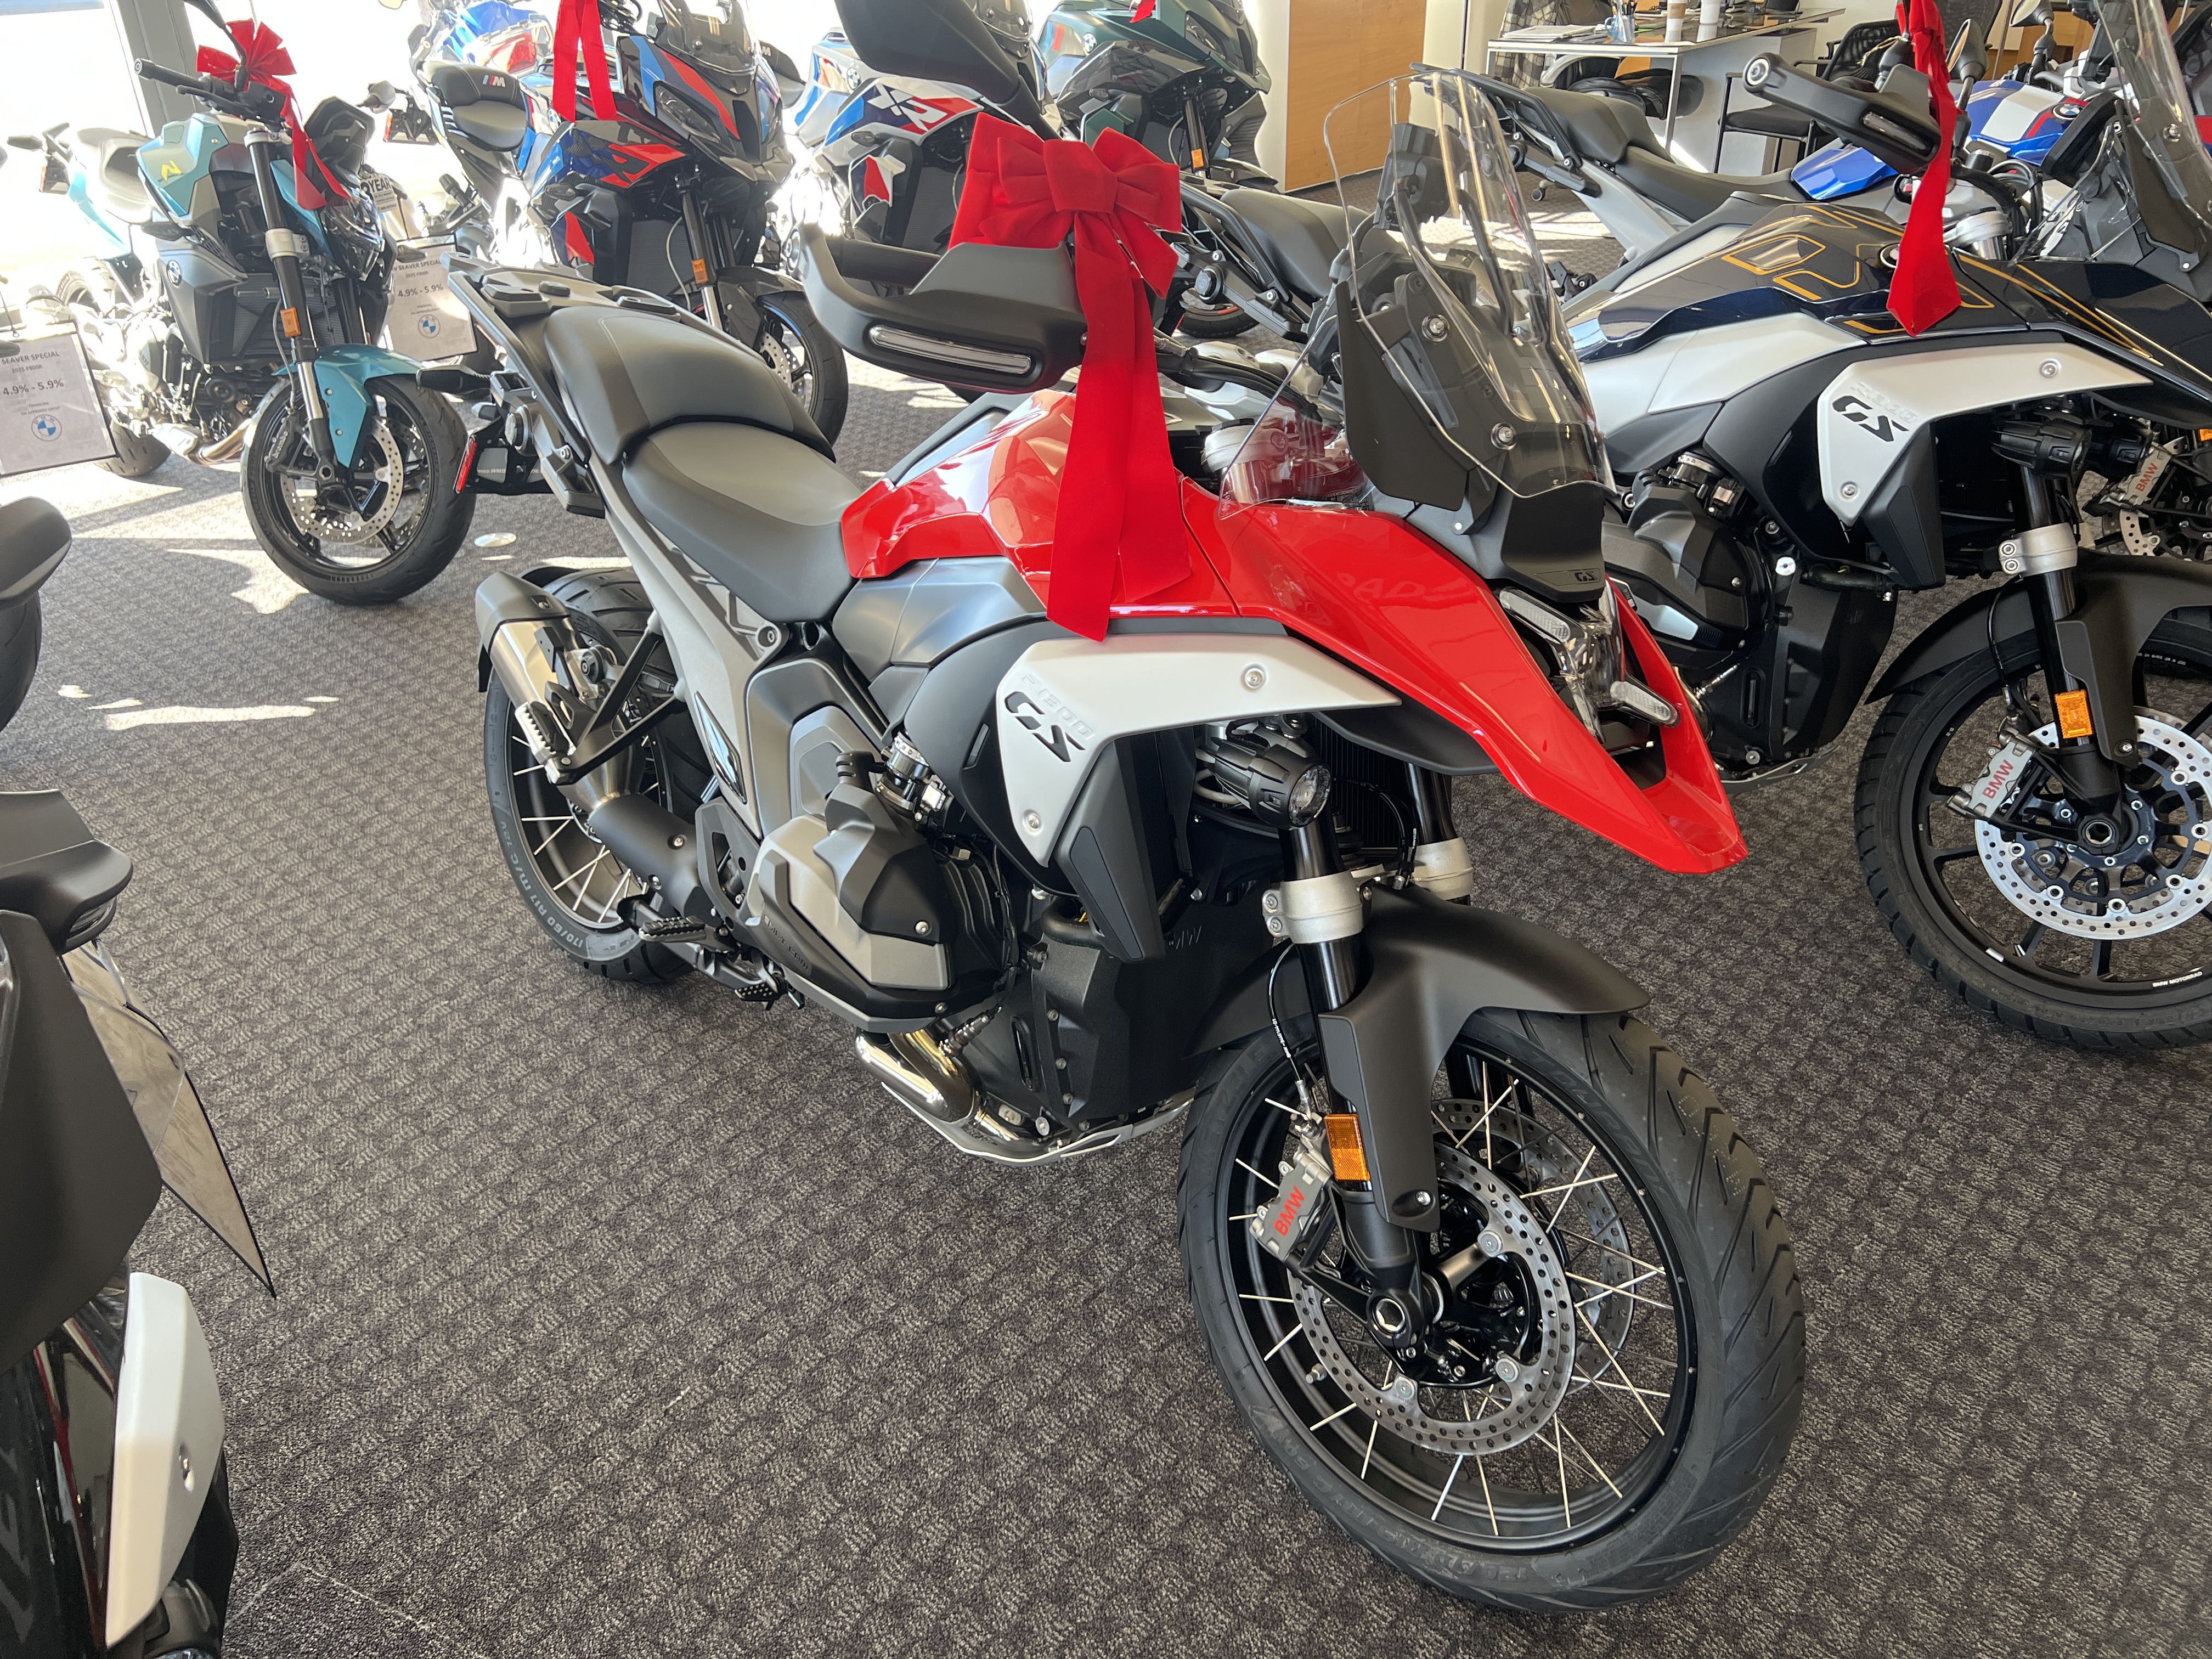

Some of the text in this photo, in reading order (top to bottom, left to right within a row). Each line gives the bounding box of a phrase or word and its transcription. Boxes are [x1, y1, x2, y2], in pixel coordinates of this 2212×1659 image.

[368, 177, 392, 192] YEAR
[398, 287, 418, 298] 4.9%
[424, 283, 444, 294] 5.9%
[2, 351, 60, 365] SEAVER SPECIAL
[3, 384, 29, 396] 4.9%
[37, 378, 64, 391] 5.9%
[272, 431, 288, 459] brembo
[2135, 462, 2158, 492] BMW
[1575, 571, 1598, 582] GS
[1005, 691, 1086, 762] GS
[1982, 759, 2013, 799] BMW
[2169, 971, 2203, 984] MOTORRAD
[1274, 1184, 1305, 1237] BMW
